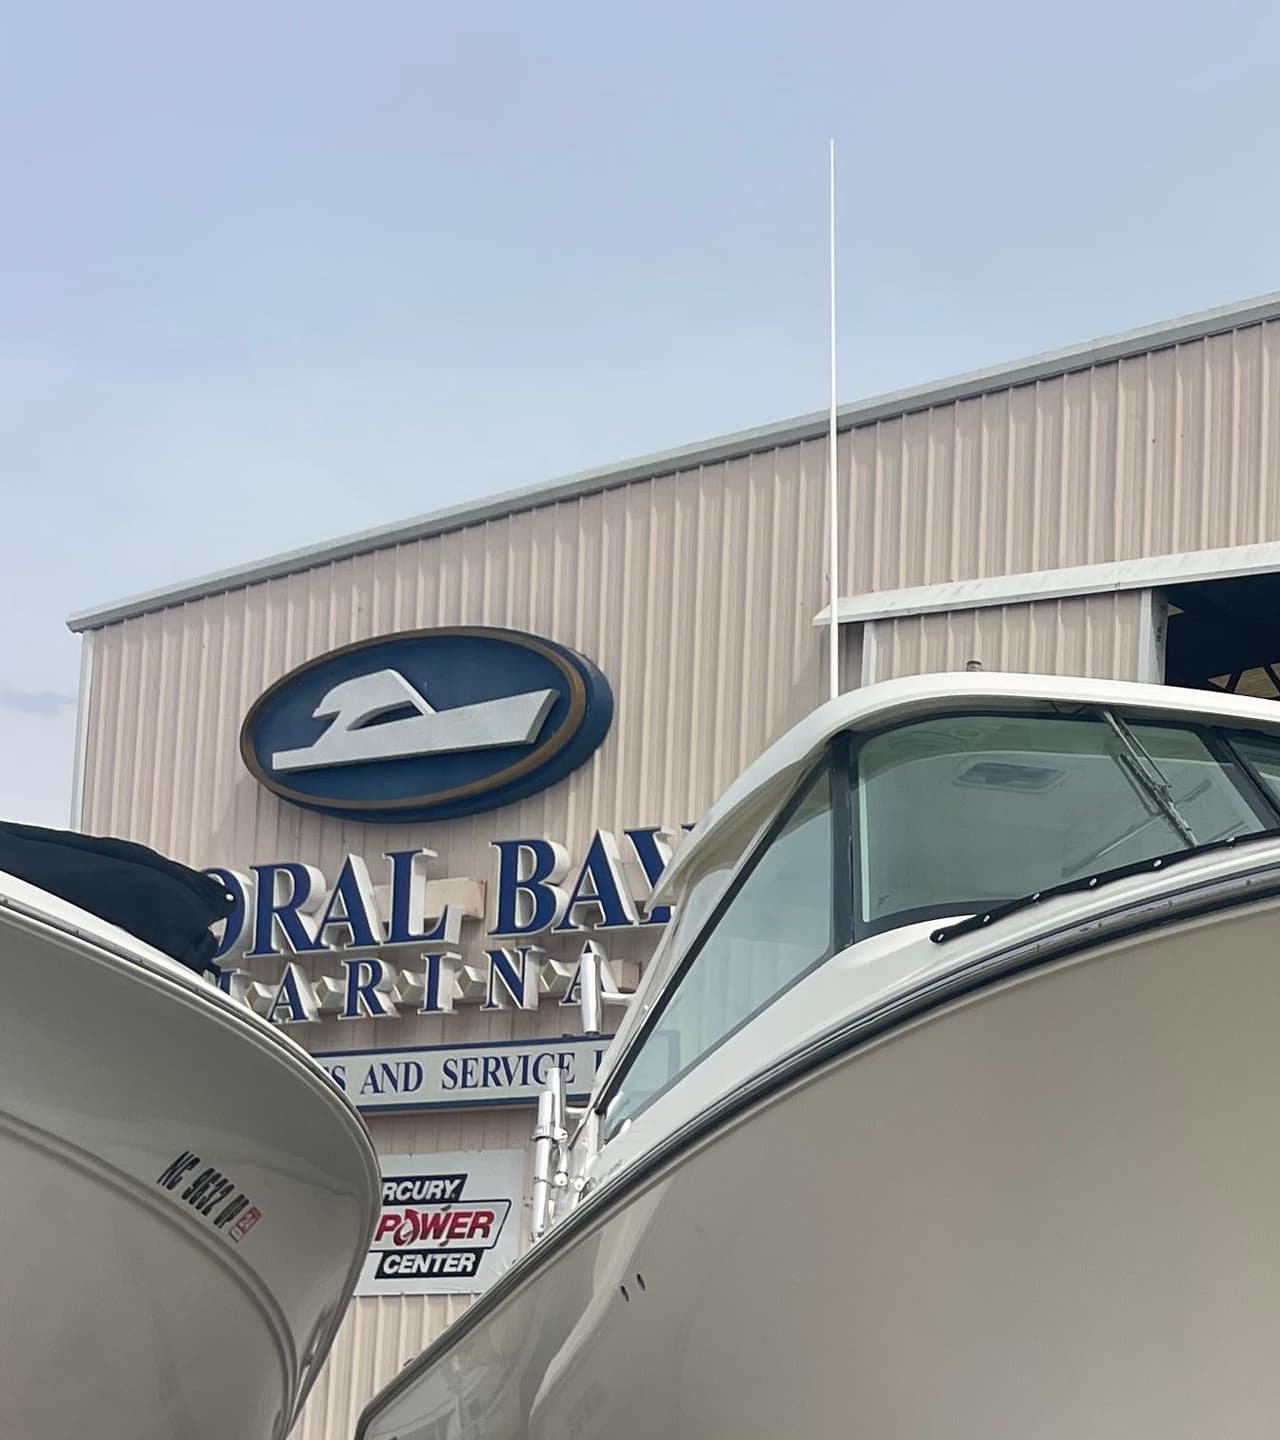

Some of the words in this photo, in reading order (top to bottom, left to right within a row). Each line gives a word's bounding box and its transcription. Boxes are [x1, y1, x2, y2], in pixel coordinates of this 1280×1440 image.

[201, 848, 455, 960] ORAL
[360, 1060, 424, 1095] AND
[441, 1051, 576, 1090] SERVICE
[382, 1178, 462, 1201] RCURY
[374, 1208, 495, 1247] POWER
[383, 1252, 476, 1275] CENTER
